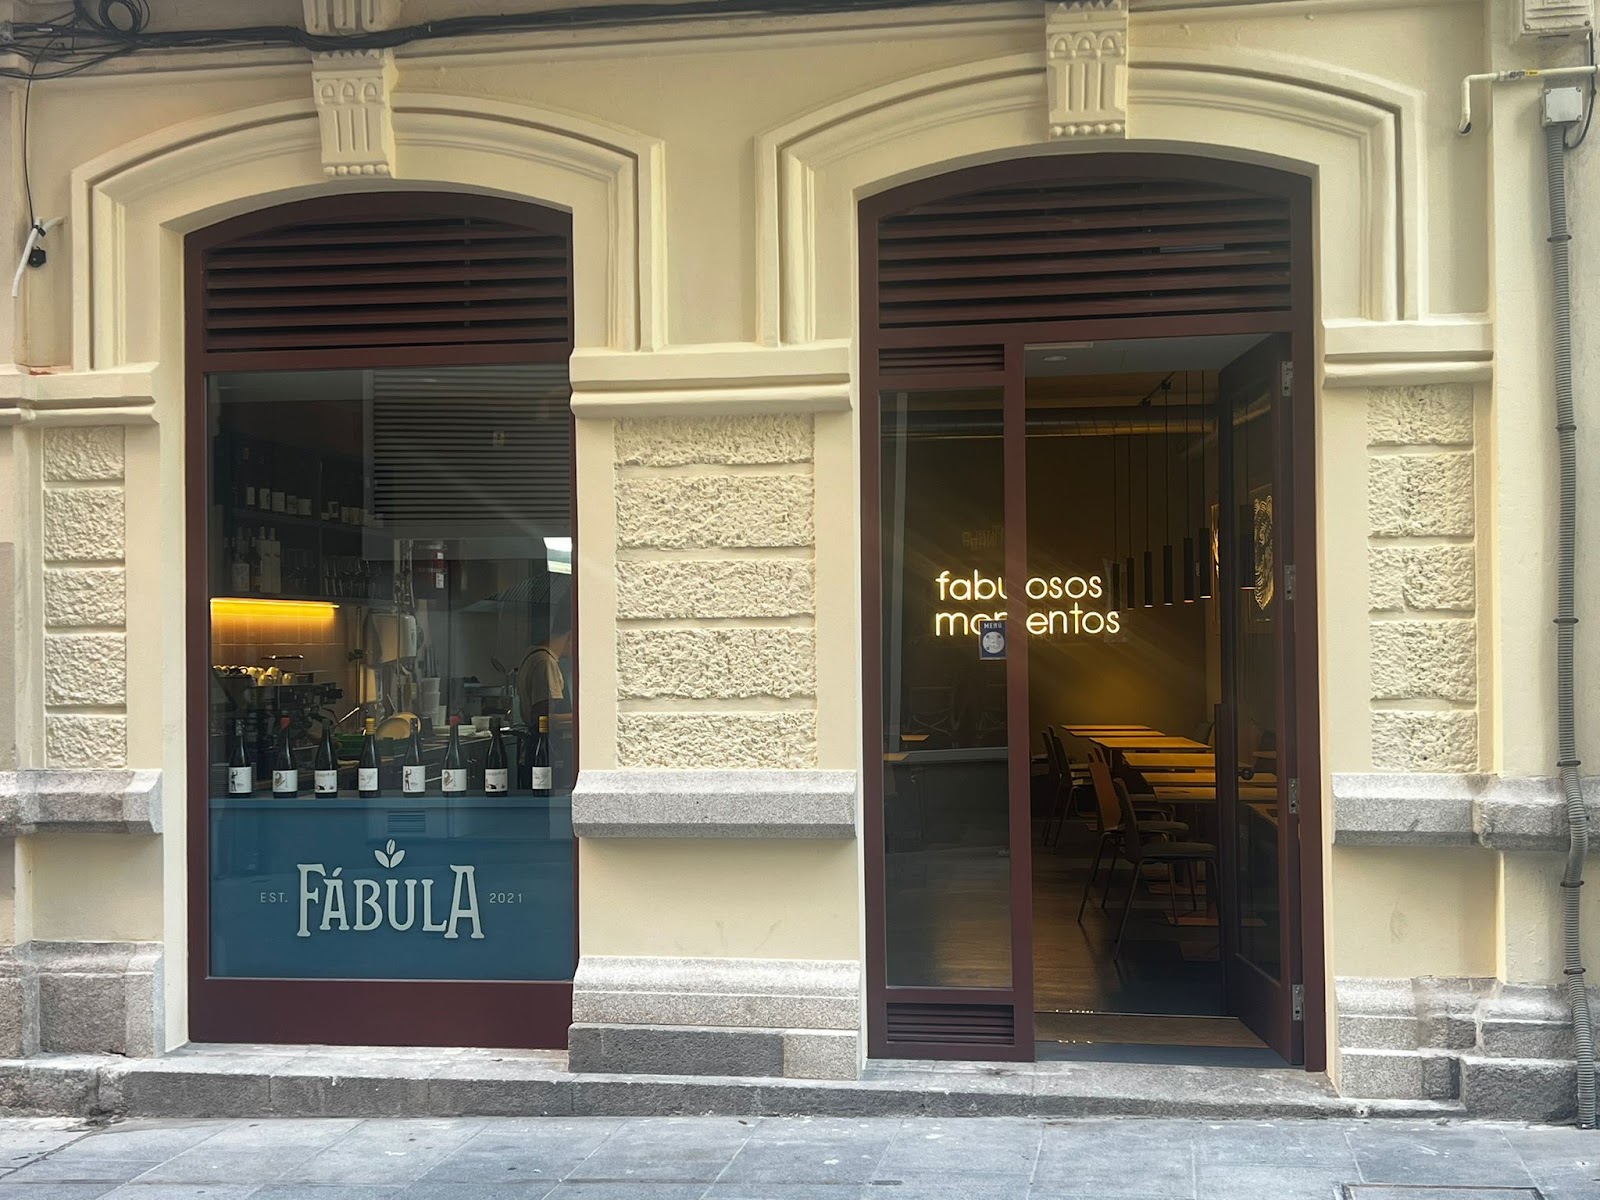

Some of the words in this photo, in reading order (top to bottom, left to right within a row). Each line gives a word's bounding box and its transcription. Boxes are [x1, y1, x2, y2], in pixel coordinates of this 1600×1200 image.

[935, 569, 1102, 601] fabuosos
[935, 602, 1120, 636] moentos
[260, 892, 288, 903] EST.
[296, 863, 485, 938] FÁBULA
[488, 892, 523, 904] 2021
